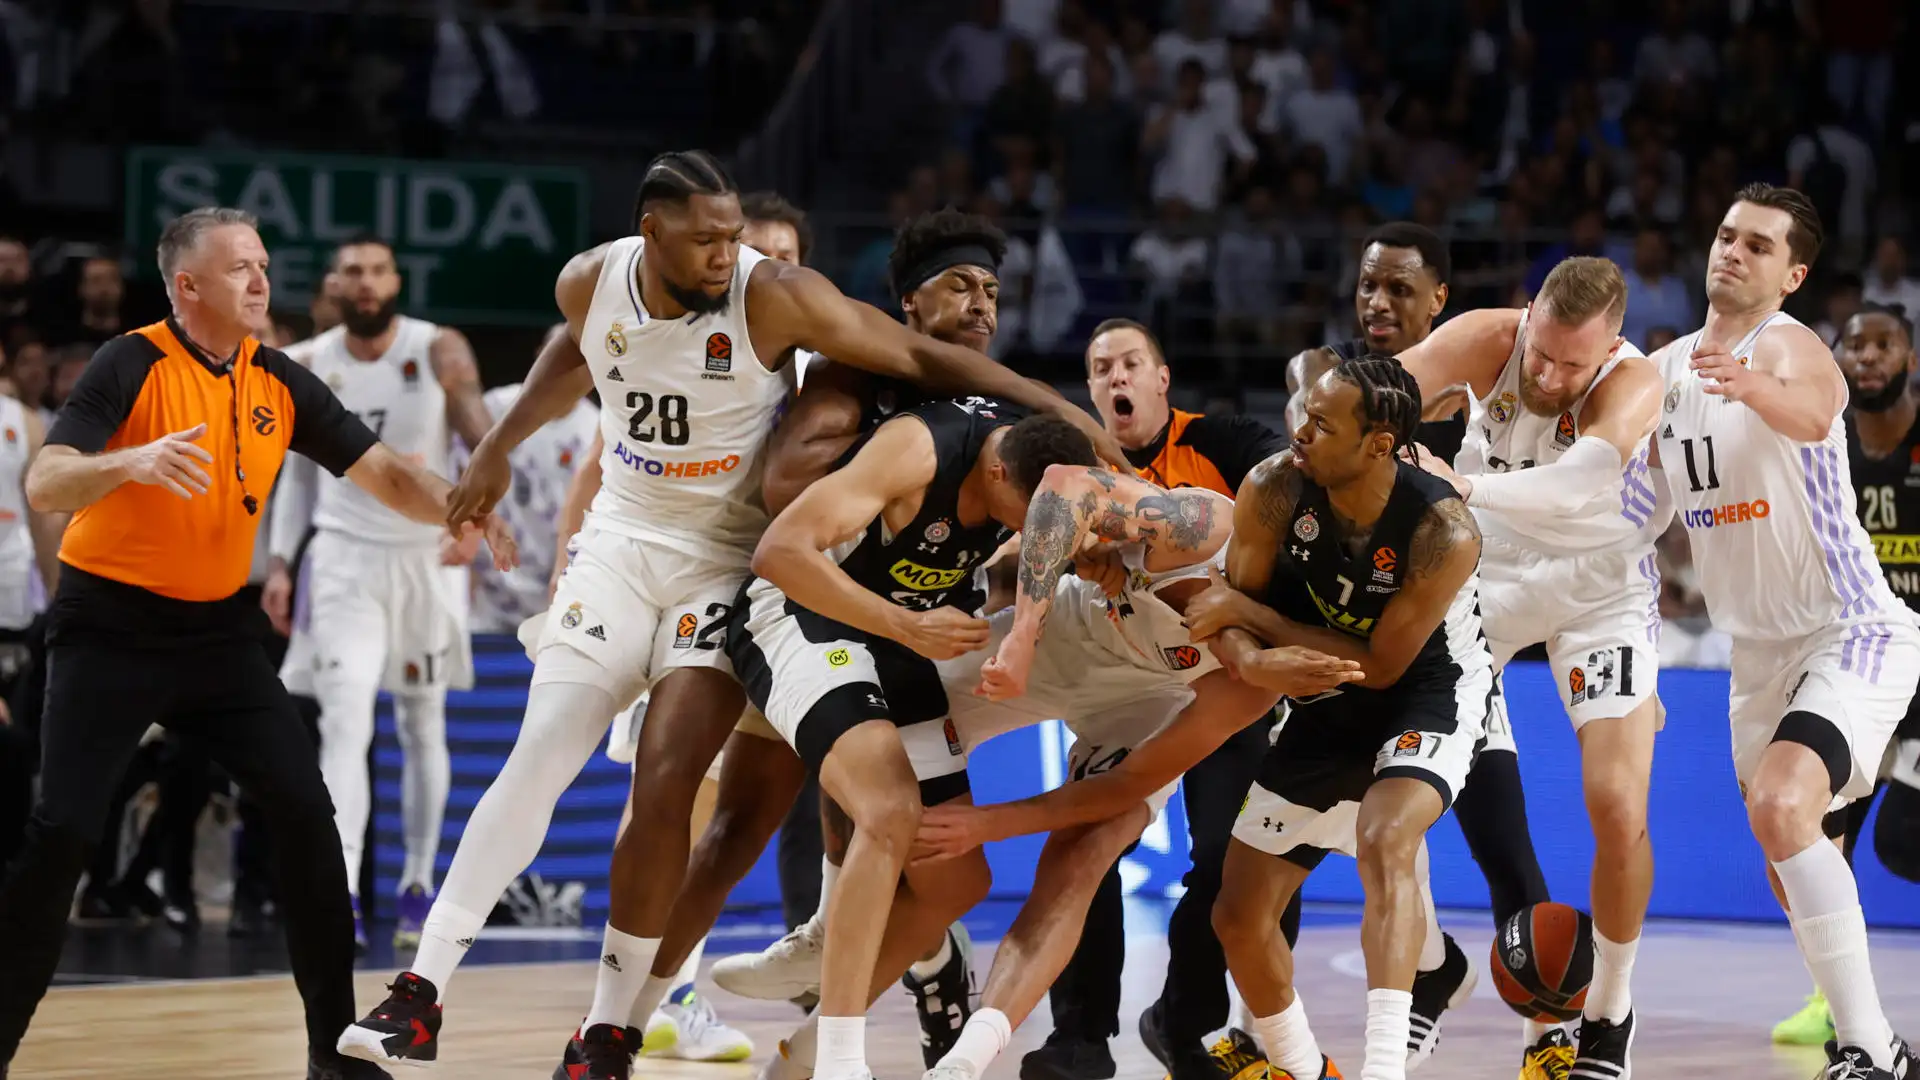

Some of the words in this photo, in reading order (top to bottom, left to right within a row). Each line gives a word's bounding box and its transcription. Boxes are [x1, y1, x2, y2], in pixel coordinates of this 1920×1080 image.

[156, 162, 555, 253] SALIDA
[271, 246, 443, 309] ET
[626, 391, 690, 445] 28
[613, 441, 741, 478] AUTOHERO
[1681, 436, 1720, 492] 11
[1685, 499, 1770, 528] UTOHERO
[1862, 485, 1898, 531] 26
[1336, 574, 1354, 606] 7
[694, 602, 733, 651] 2
[1587, 646, 1636, 700] 31
[1427, 735, 1442, 759] 7
